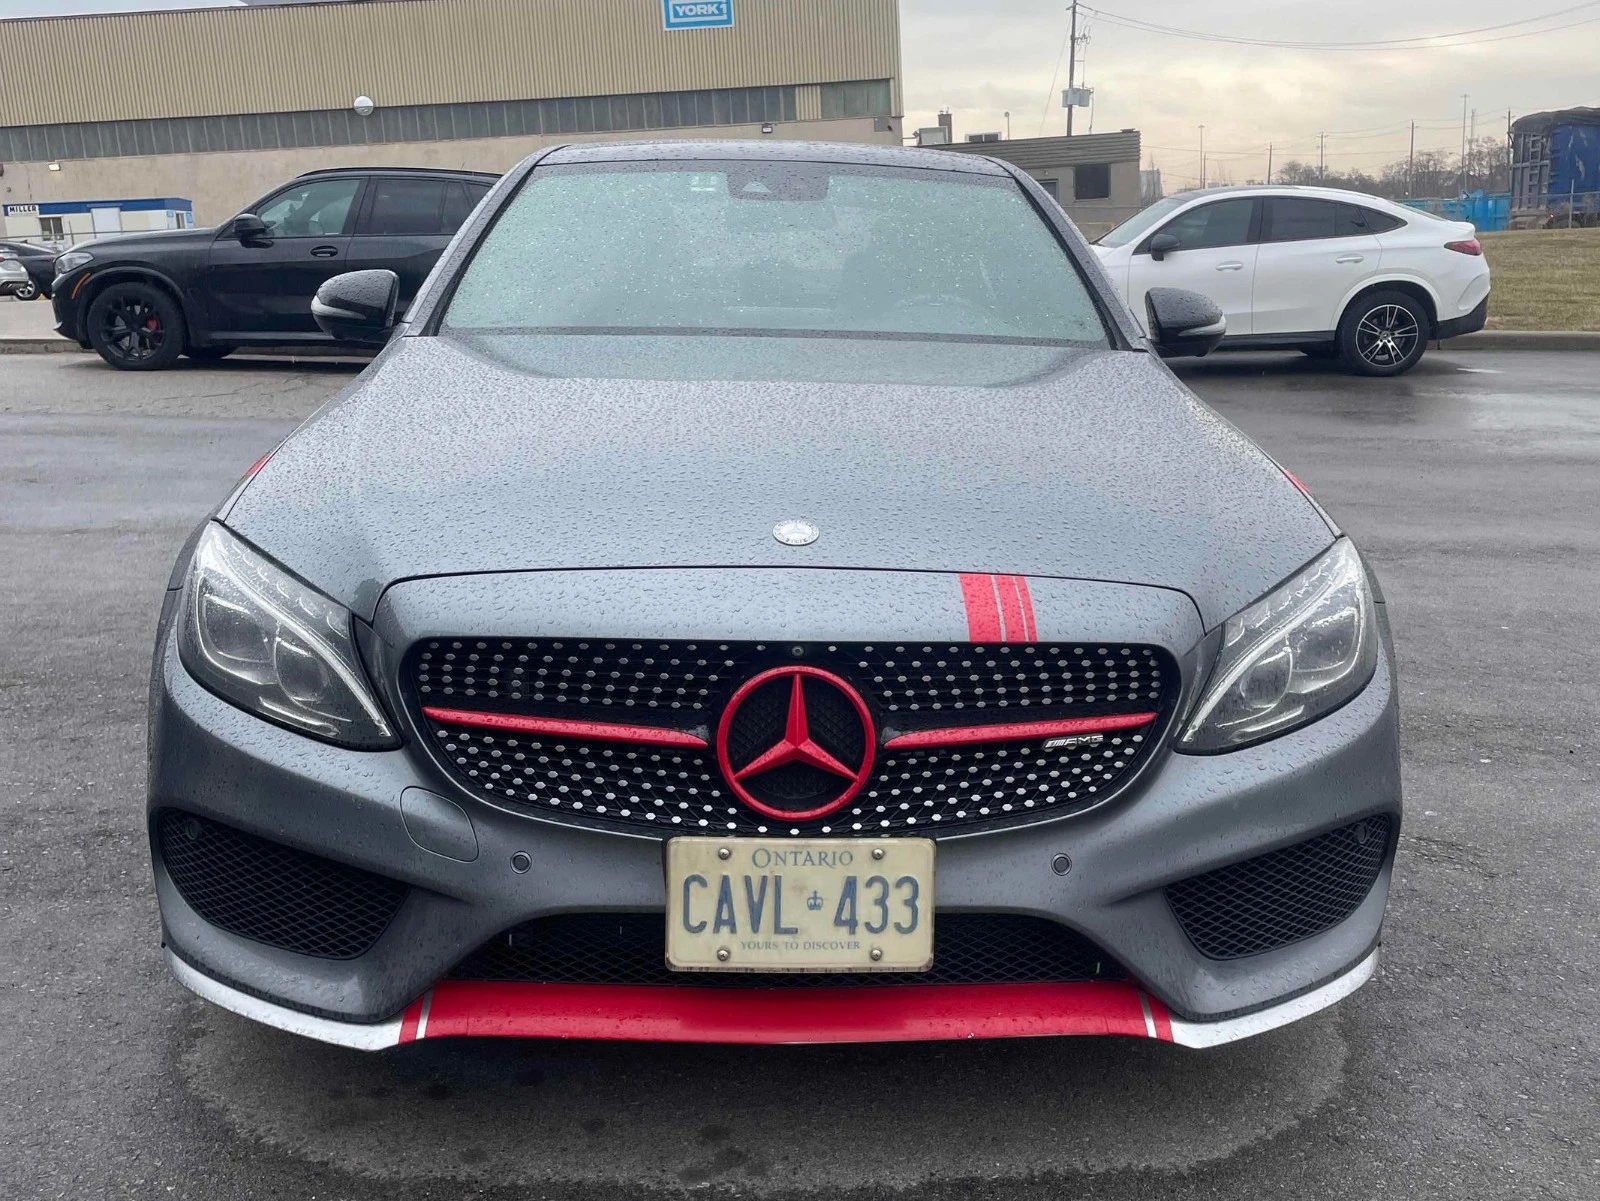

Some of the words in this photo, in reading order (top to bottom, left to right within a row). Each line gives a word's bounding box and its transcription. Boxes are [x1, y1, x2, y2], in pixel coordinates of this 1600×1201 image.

[1062, 735, 1103, 746] AMG
[752, 848, 853, 868] ONTARIO
[683, 874, 798, 935] CAVL
[833, 875, 919, 935] 433
[741, 941, 779, 950] YOURS
[784, 941, 799, 950] TO
[803, 941, 860, 950] DISCOVER
